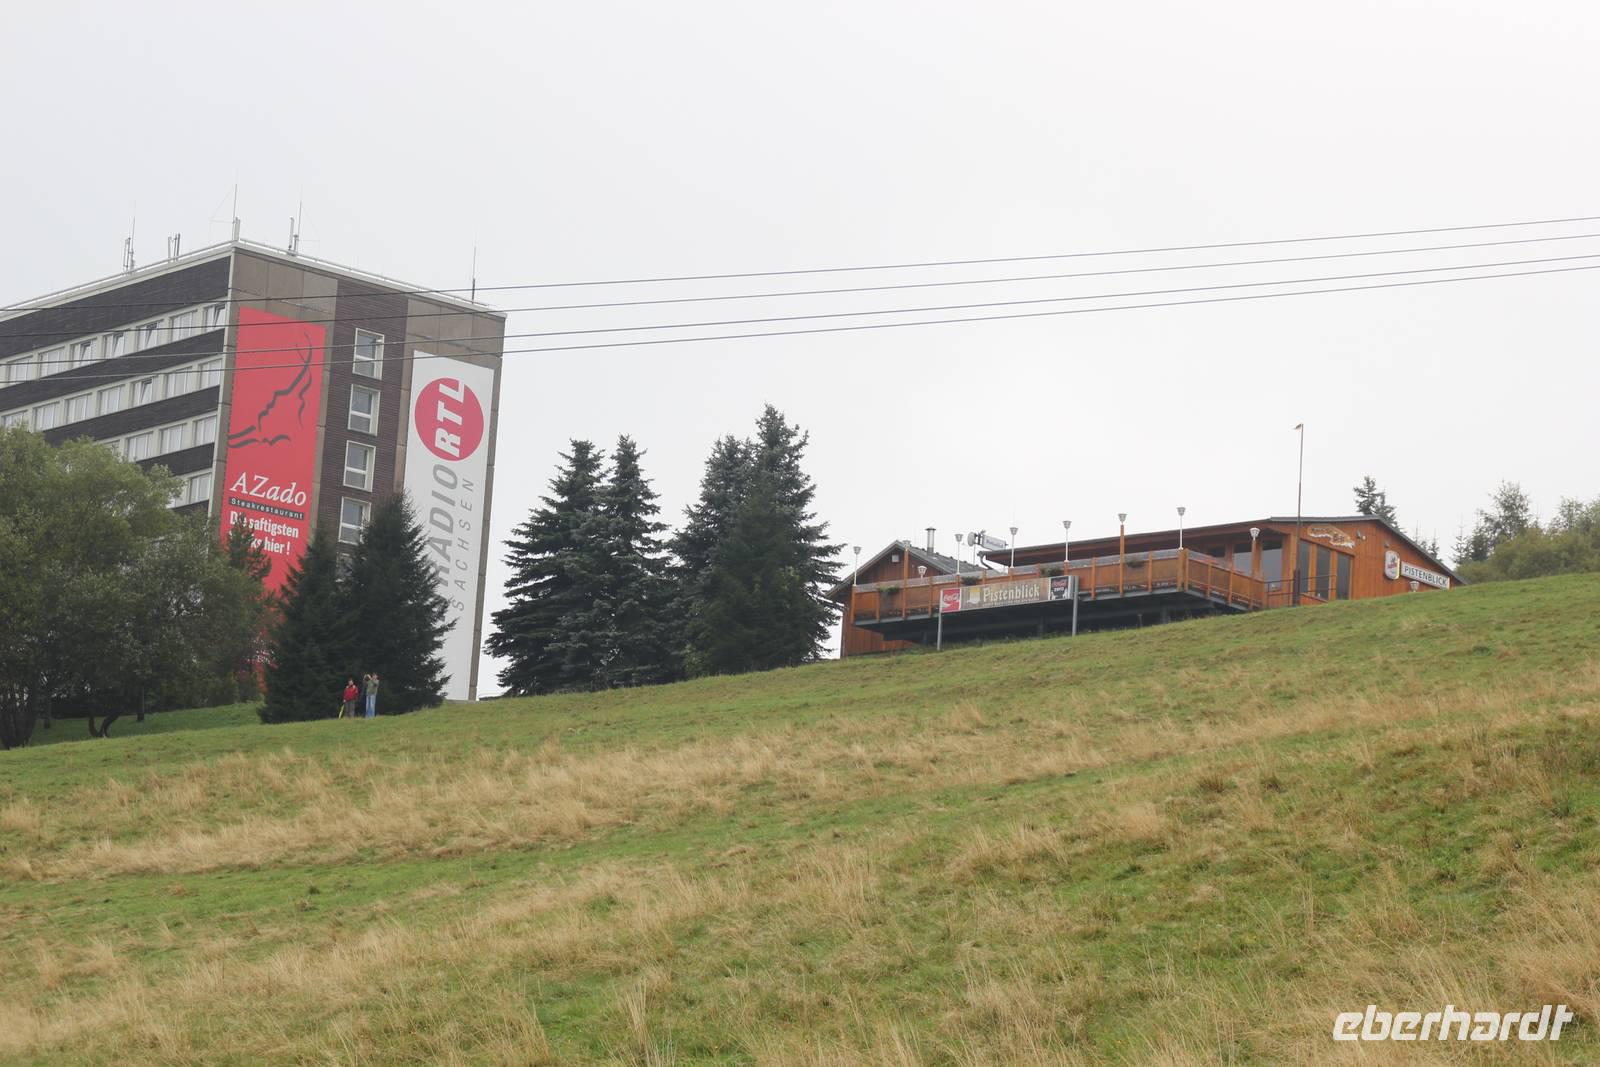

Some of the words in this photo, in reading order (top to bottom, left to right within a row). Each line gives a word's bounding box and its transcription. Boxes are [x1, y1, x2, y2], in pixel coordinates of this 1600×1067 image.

[435, 378, 465, 458] RTL
[229, 471, 307, 506] AZado
[231, 498, 304, 519] Steakrestaurant
[249, 517, 299, 538] saftigsten
[452, 478, 474, 612] SACHSEN
[1404, 565, 1448, 586] PISTENBLICK
[983, 583, 1040, 603] Pistenblick
